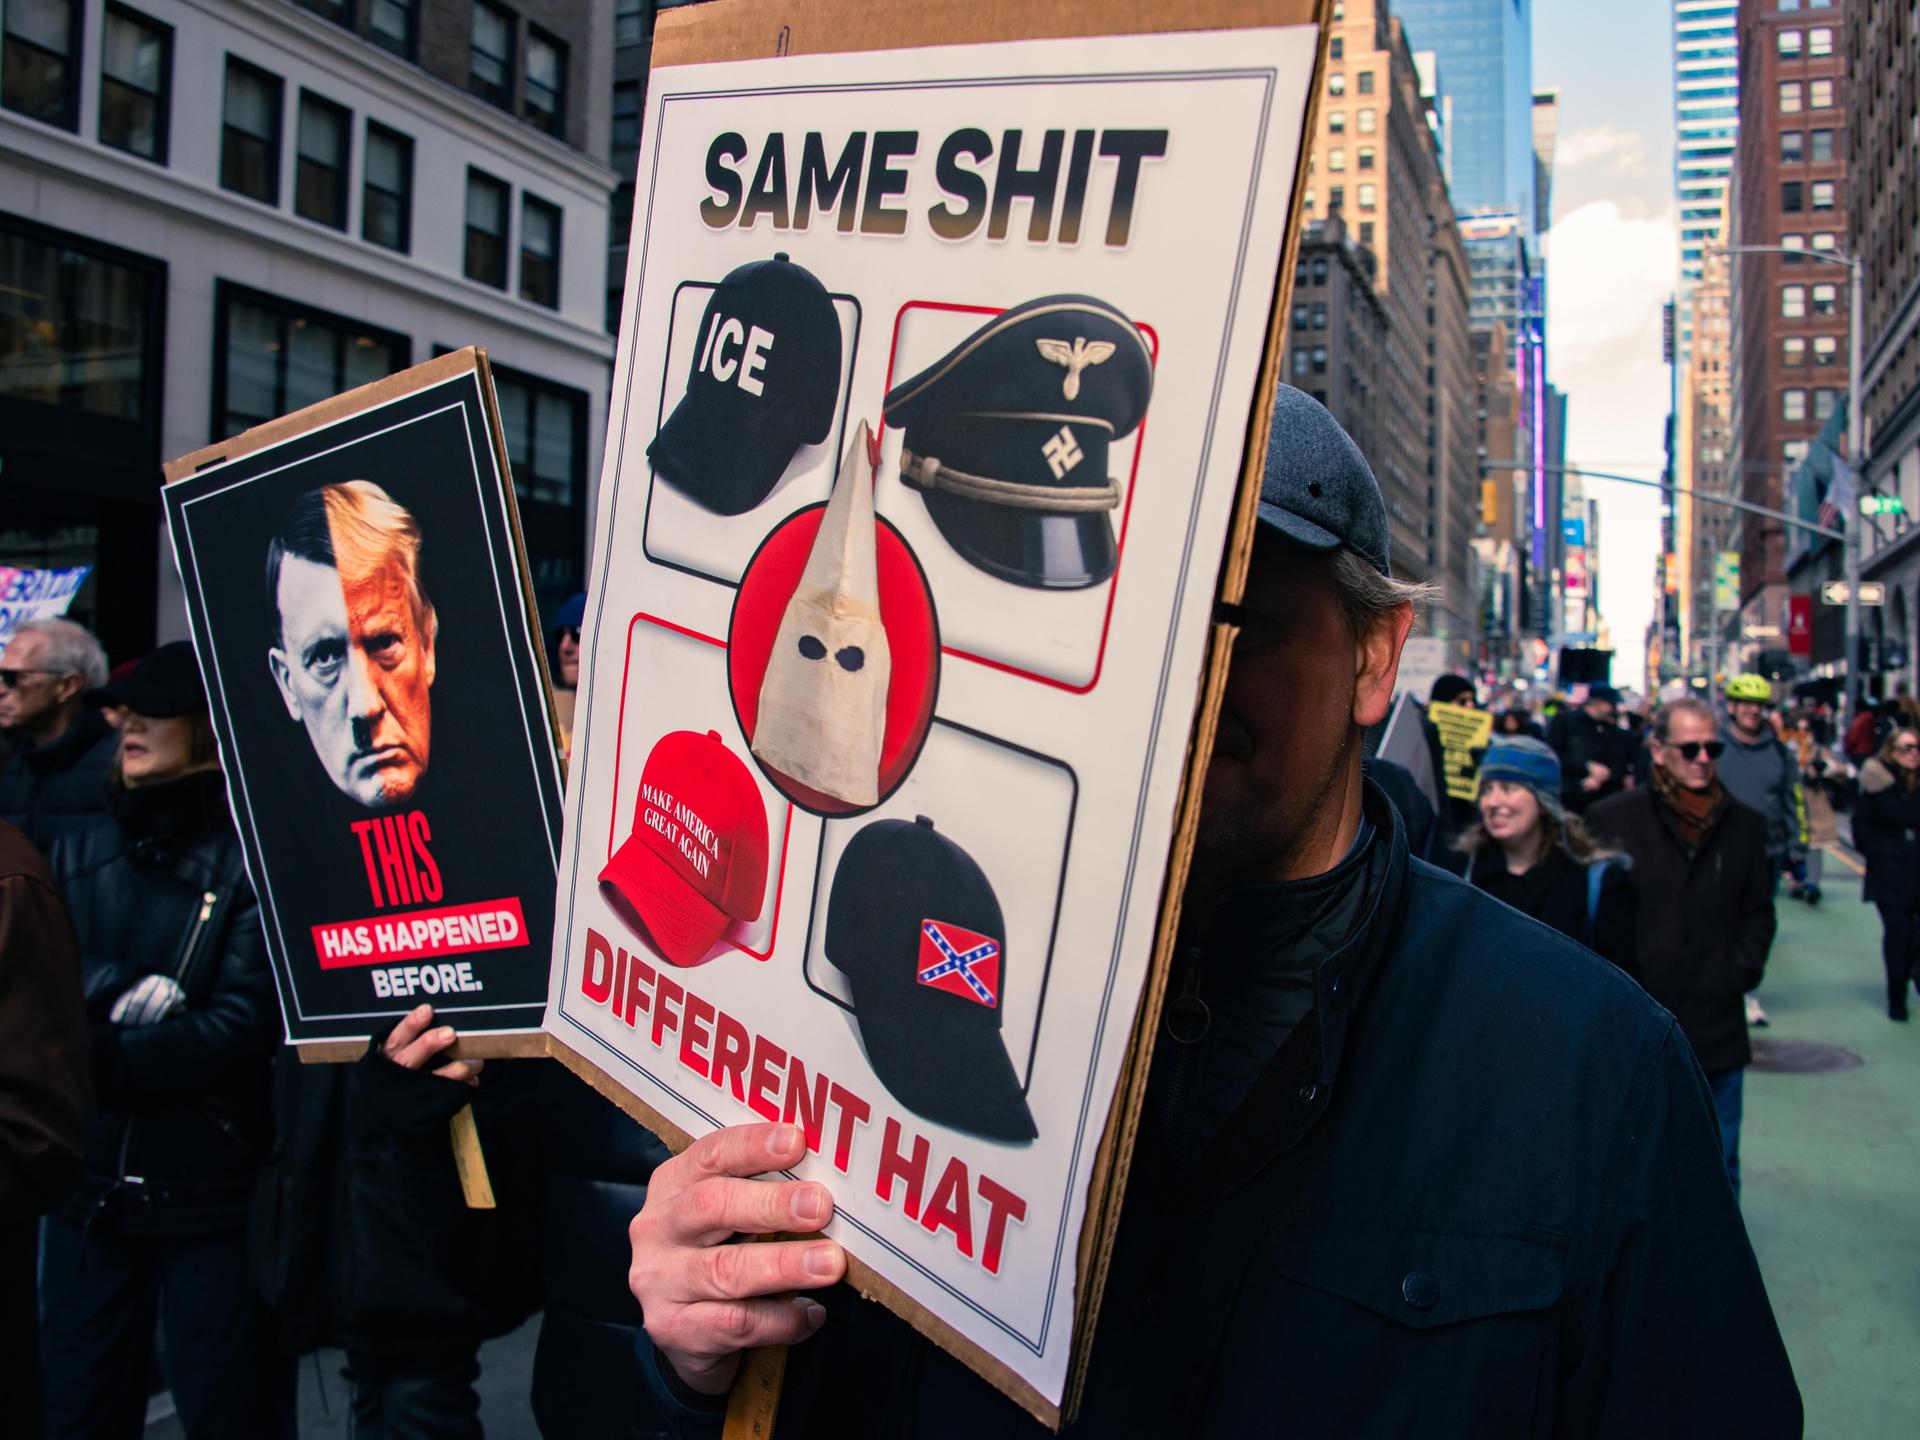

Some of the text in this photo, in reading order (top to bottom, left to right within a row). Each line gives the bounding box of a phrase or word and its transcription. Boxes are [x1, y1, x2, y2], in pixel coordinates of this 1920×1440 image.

[699, 126, 1170, 247] SAME SHIT
[699, 311, 775, 398] ICE
[350, 810, 444, 908] THIS
[642, 784, 719, 860] MAKE AMERICA
[644, 808, 710, 879] GREAT AGAIN
[321, 910, 519, 959] HAS HAPPENED
[371, 961, 483, 998] BEFORE.
[581, 927, 1027, 1276] DIFFERENT HAT
